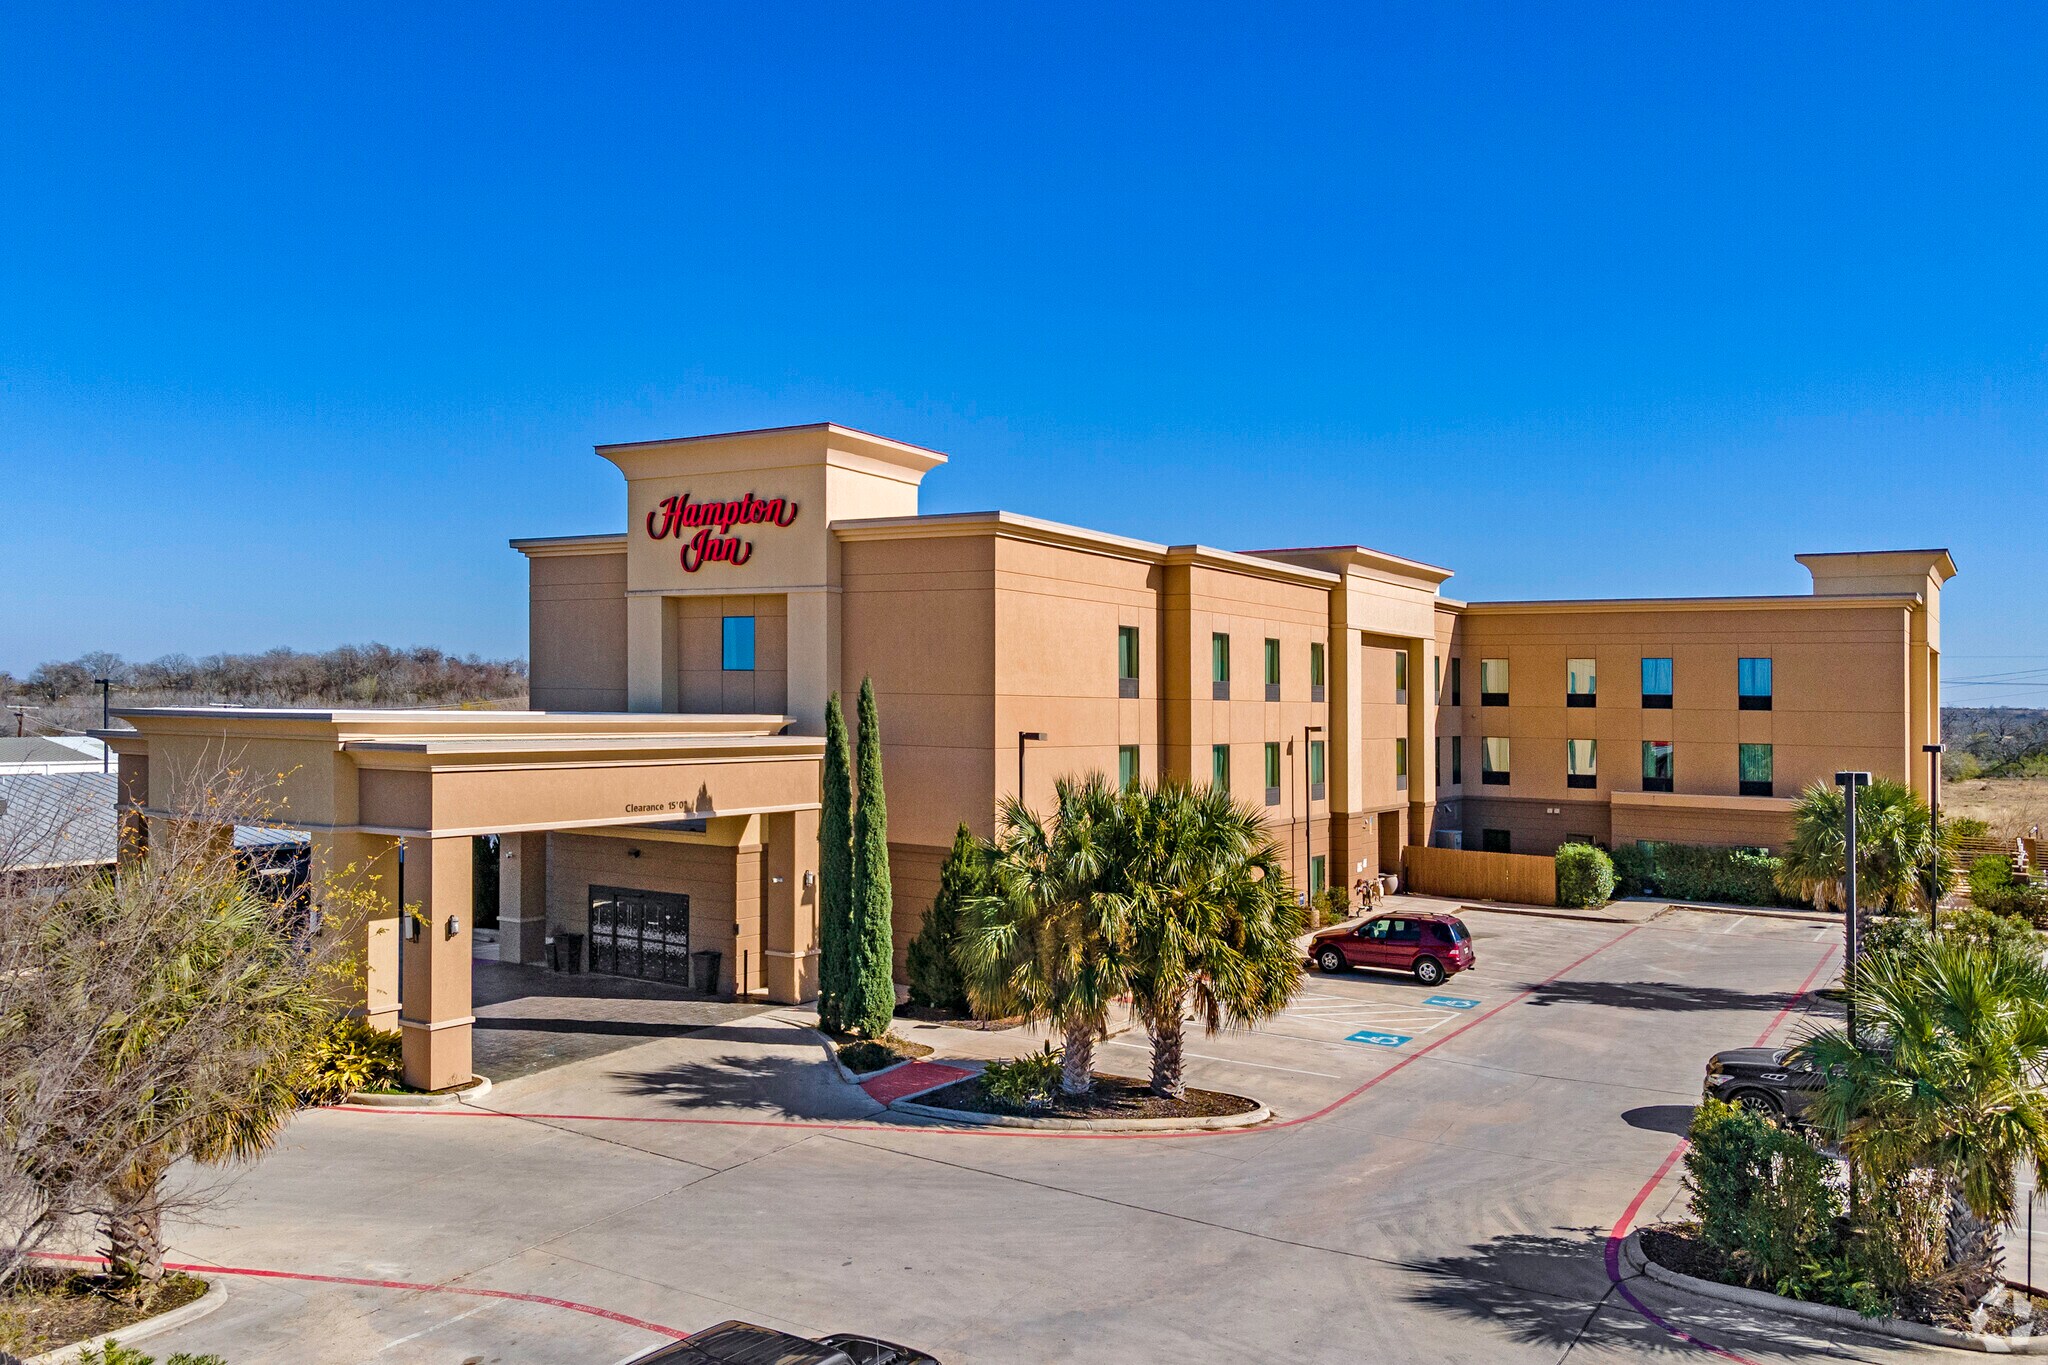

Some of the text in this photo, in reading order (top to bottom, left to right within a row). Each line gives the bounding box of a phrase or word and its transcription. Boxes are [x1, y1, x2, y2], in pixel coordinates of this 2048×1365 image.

[646, 493, 798, 539] Hampton
[680, 529, 752, 573] Inn
[625, 803, 664, 813] Clearance
